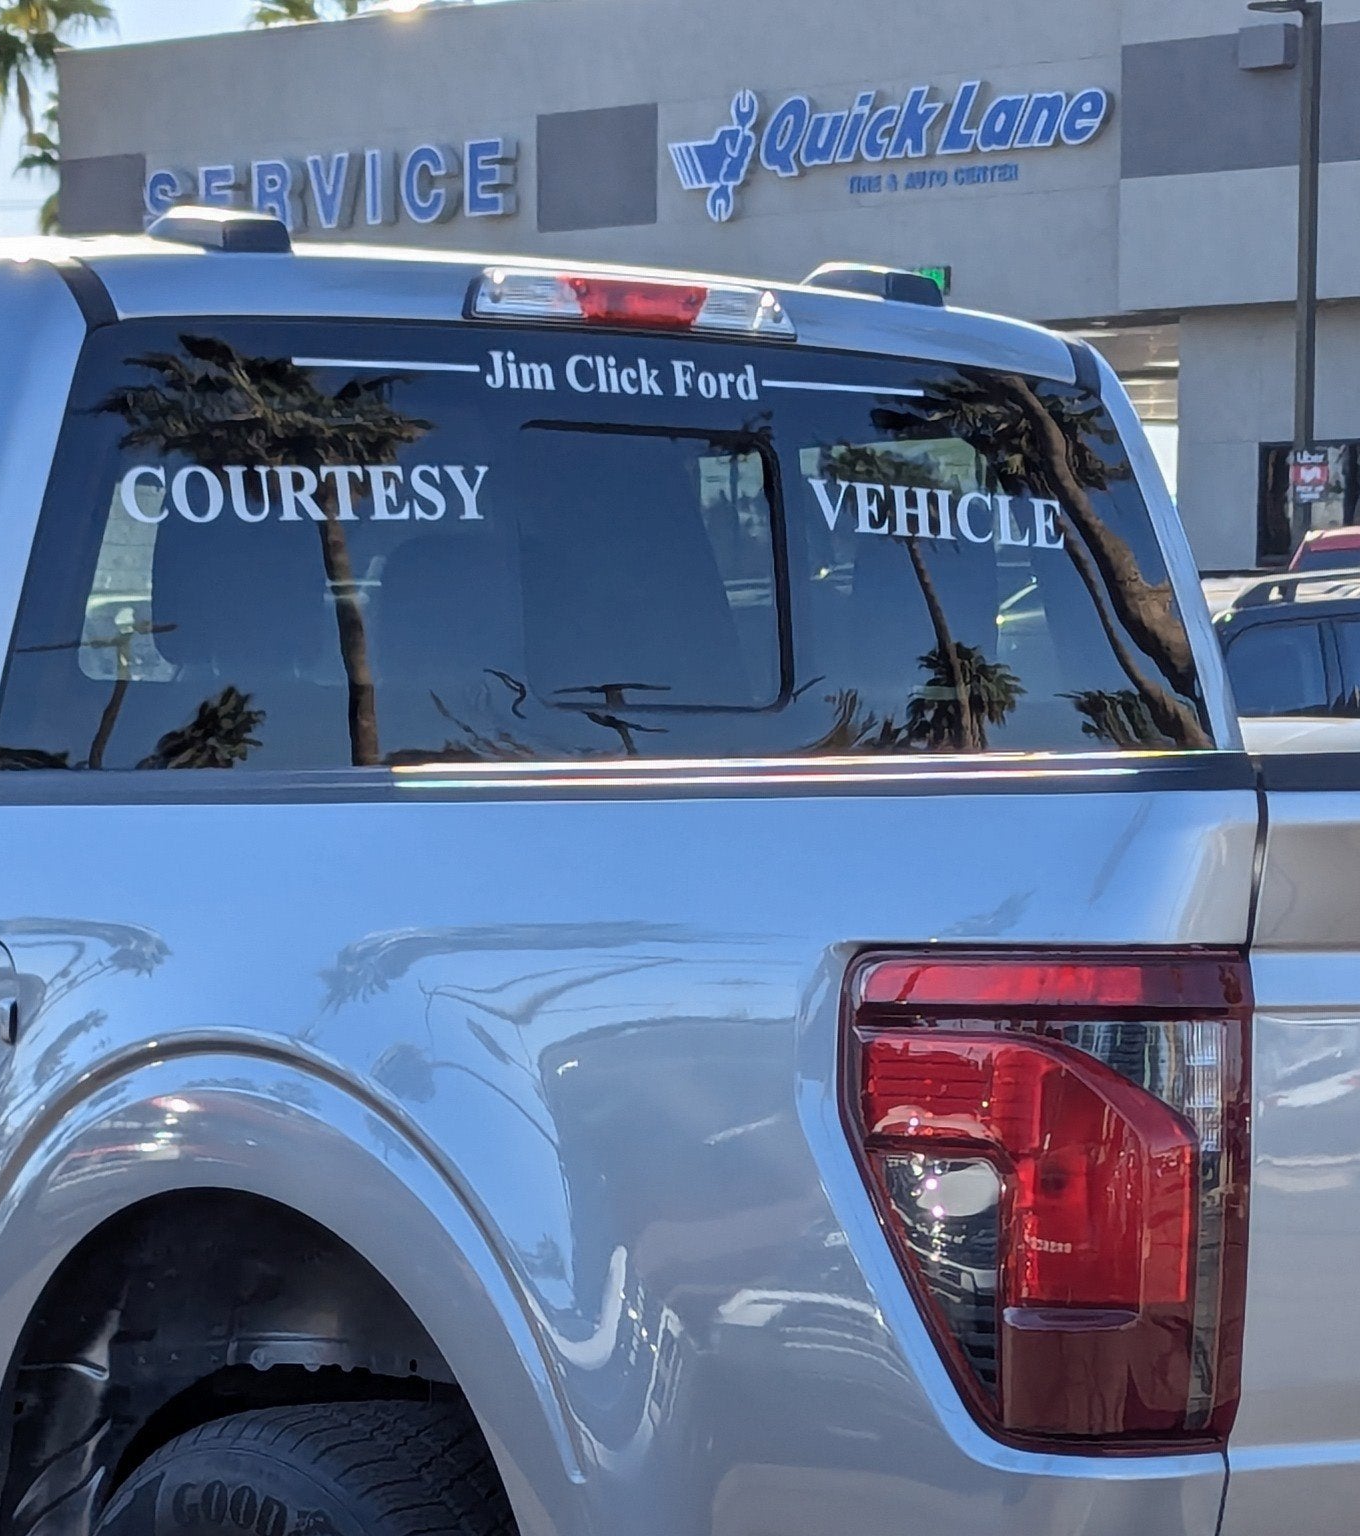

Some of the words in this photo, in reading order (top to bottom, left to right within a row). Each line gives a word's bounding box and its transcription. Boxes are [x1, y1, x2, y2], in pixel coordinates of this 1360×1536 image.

[759, 84, 944, 178] Quick
[934, 80, 1108, 156] Lane
[849, 174, 882, 194] TIRE
[886, 173, 899, 192] &
[905, 170, 948, 190] AUTO
[953, 163, 1019, 186] CENTER
[485, 350, 556, 391] Jim
[565, 354, 664, 397] Click
[670, 359, 759, 401] Ford
[120, 464, 490, 523] COURTESY
[807, 477, 1065, 550] VEHICLE
